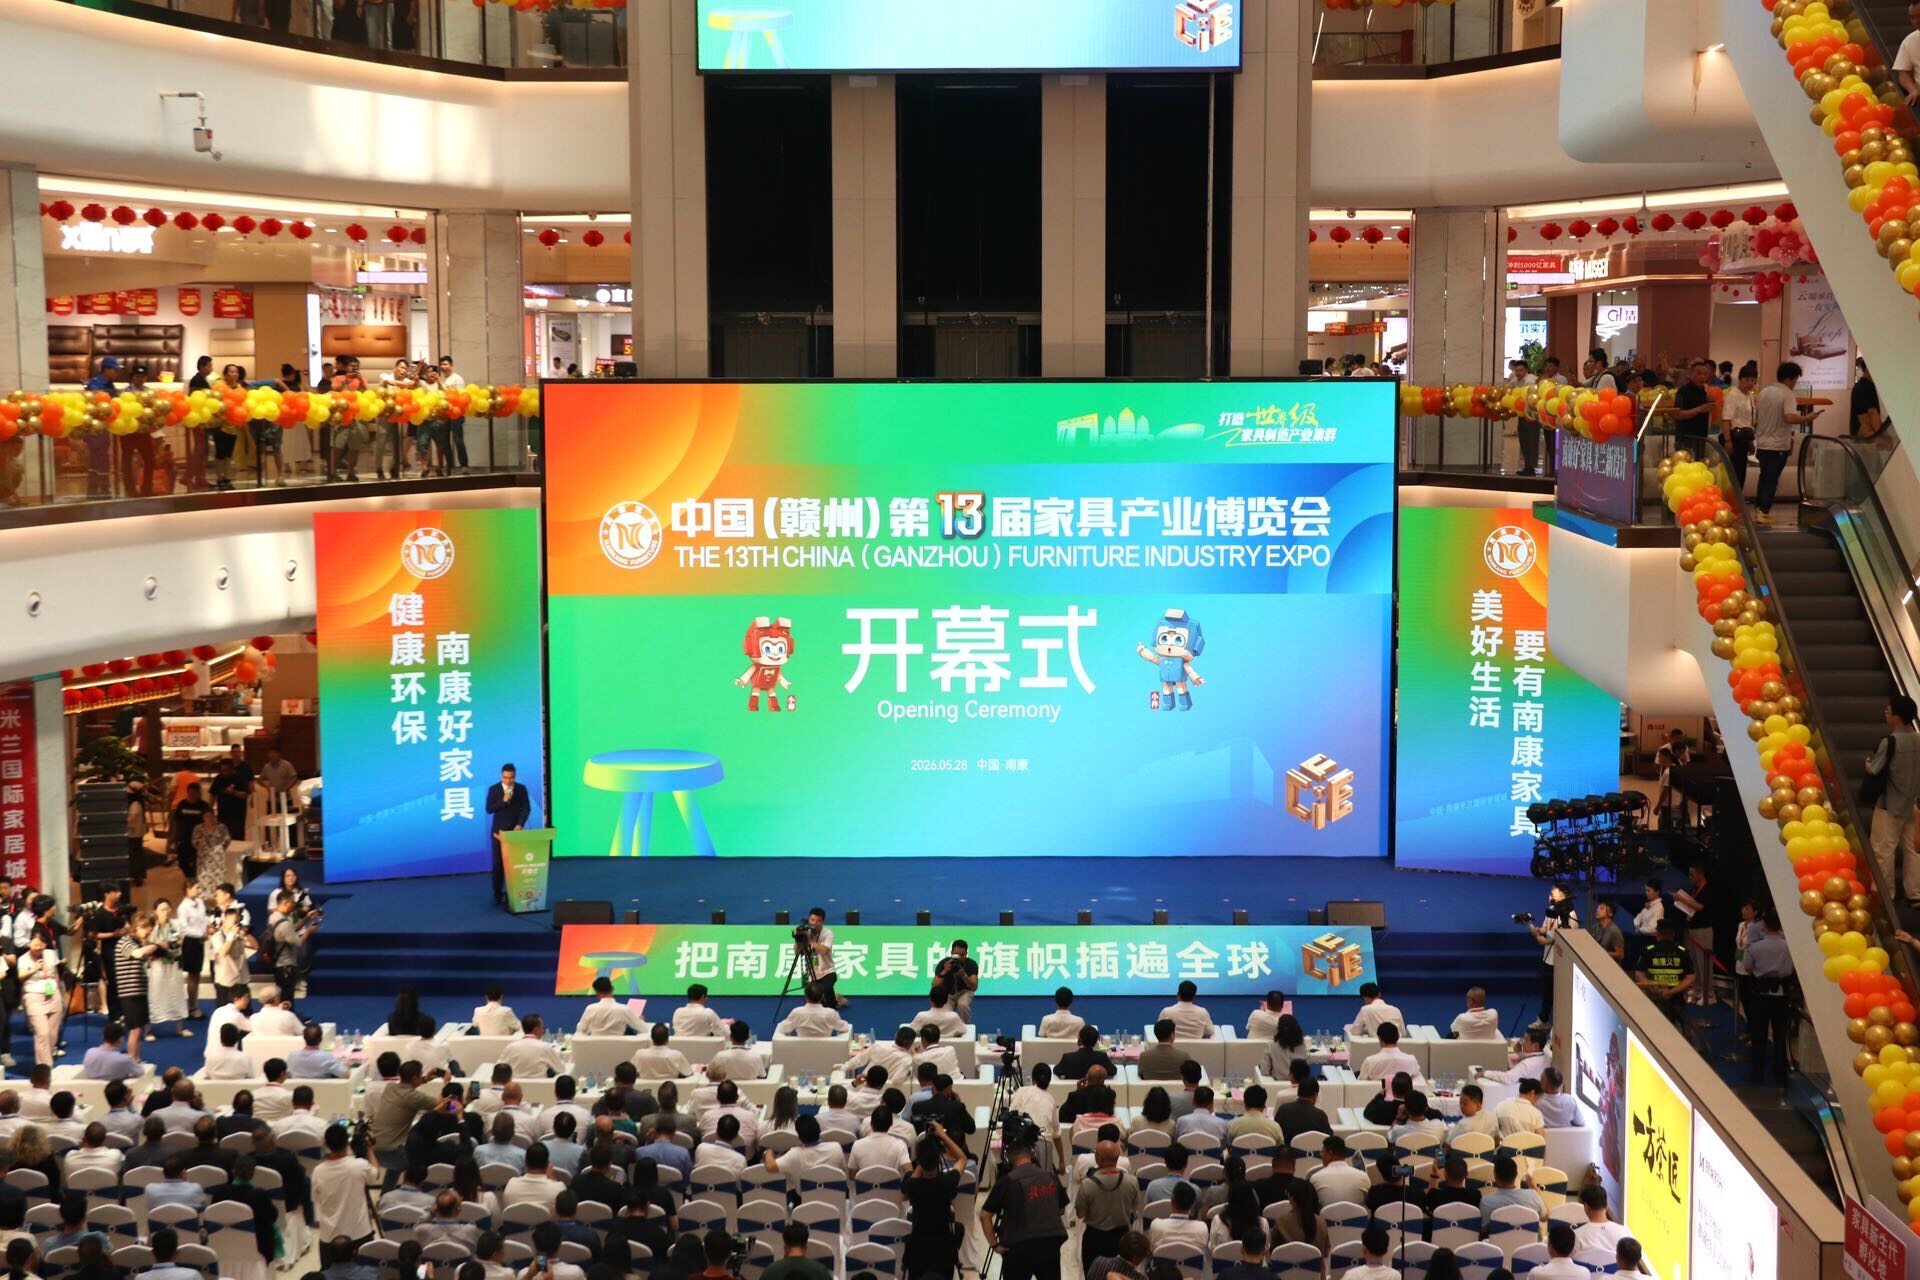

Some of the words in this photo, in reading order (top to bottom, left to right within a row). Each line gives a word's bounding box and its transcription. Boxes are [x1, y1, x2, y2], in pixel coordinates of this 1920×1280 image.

[674, 545, 721, 568] THE
[724, 545, 779, 568] 13TH
[782, 545, 855, 568] CHINA
[1008, 545, 1140, 568] FURNITURE
[1145, 545, 1262, 568] INDUSTRY
[1265, 545, 1331, 568] EXPO
[388, 592, 427, 745] 健康环保
[842, 604, 1098, 695] 开幕式
[1469, 589, 1503, 729] 美好生活
[436, 631, 475, 822] 南康好家具
[877, 700, 959, 723] Opening
[964, 700, 1062, 723] Ceremony
[1509, 629, 1546, 838] 要有南康家具
[911, 759, 968, 771] 2026.05.28
[1851, 1206, 1899, 1265] 家具新生代
